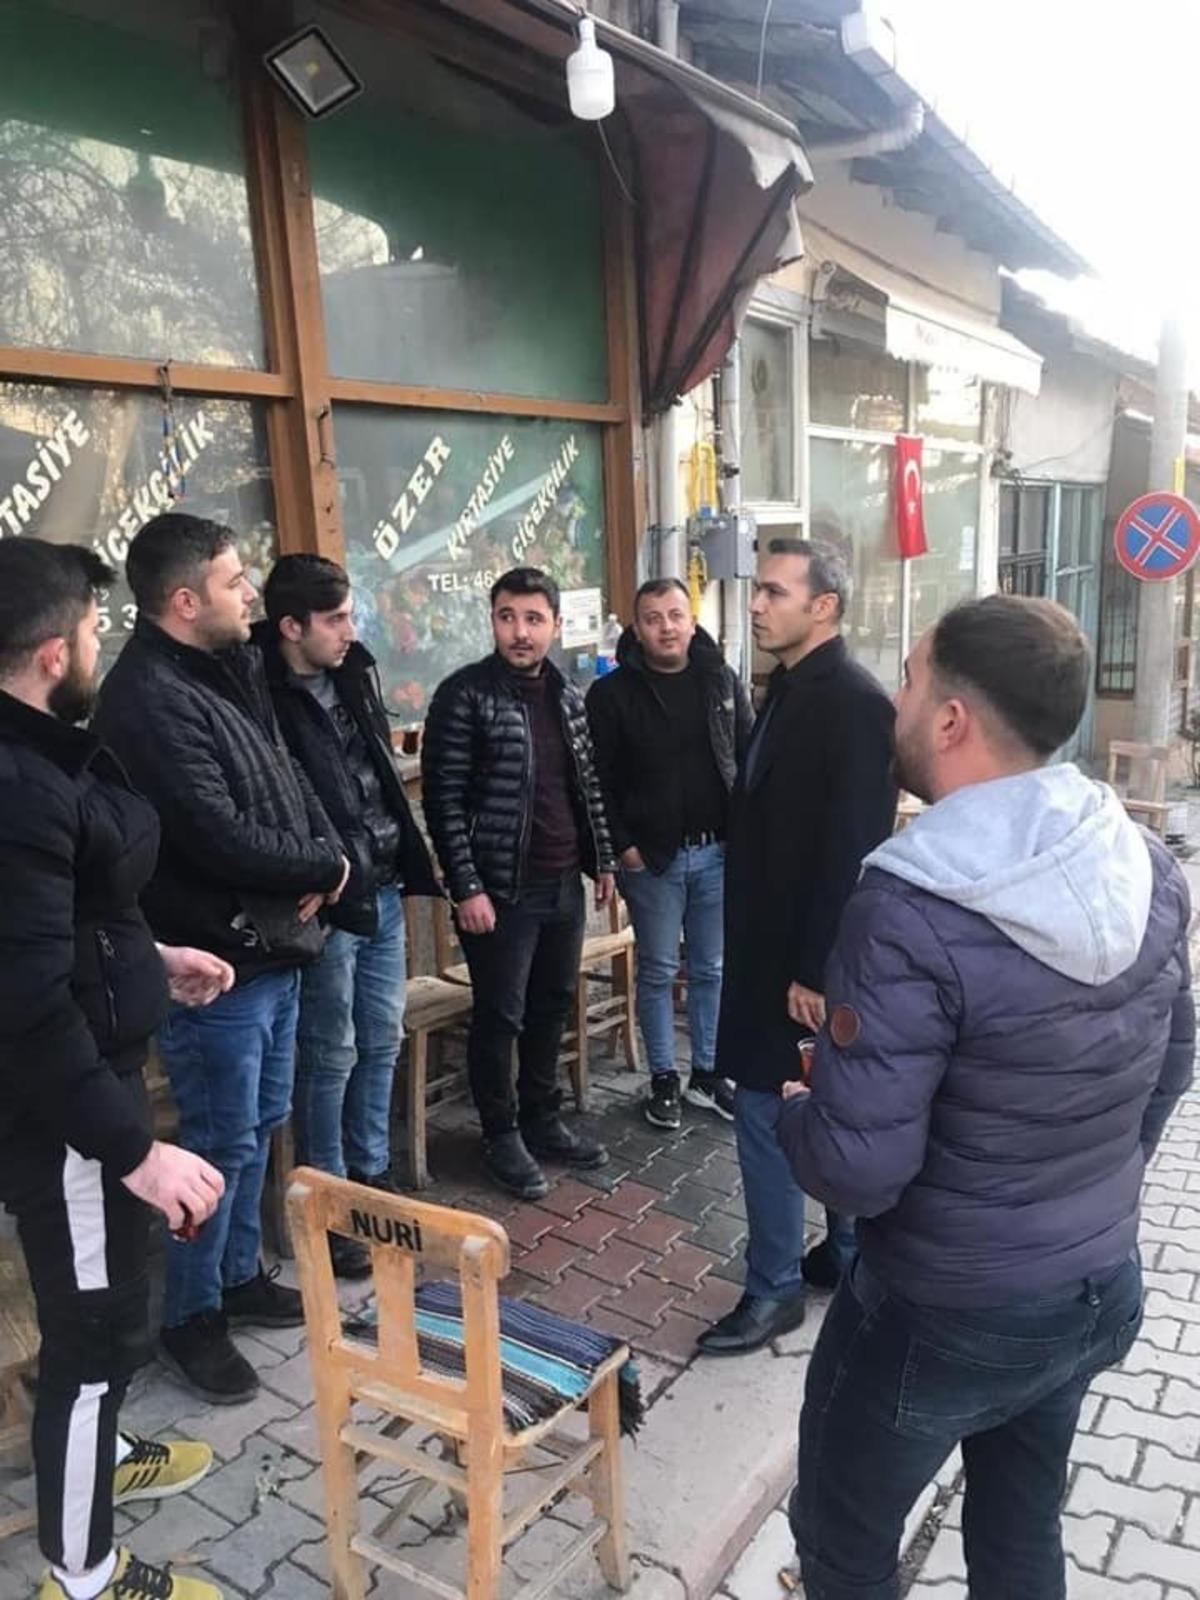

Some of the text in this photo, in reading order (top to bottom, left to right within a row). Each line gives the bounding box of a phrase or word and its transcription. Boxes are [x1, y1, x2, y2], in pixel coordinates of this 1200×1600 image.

[0, 409, 91, 538] TASİYE
[373, 436, 452, 560] ÖZER
[446, 436, 516, 560] KIRTASİYE
[511, 433, 581, 563] ÇİÇEKÇİLİK
[428, 569, 500, 594] TEL: 46
[350, 1208, 423, 1253] NURİ
